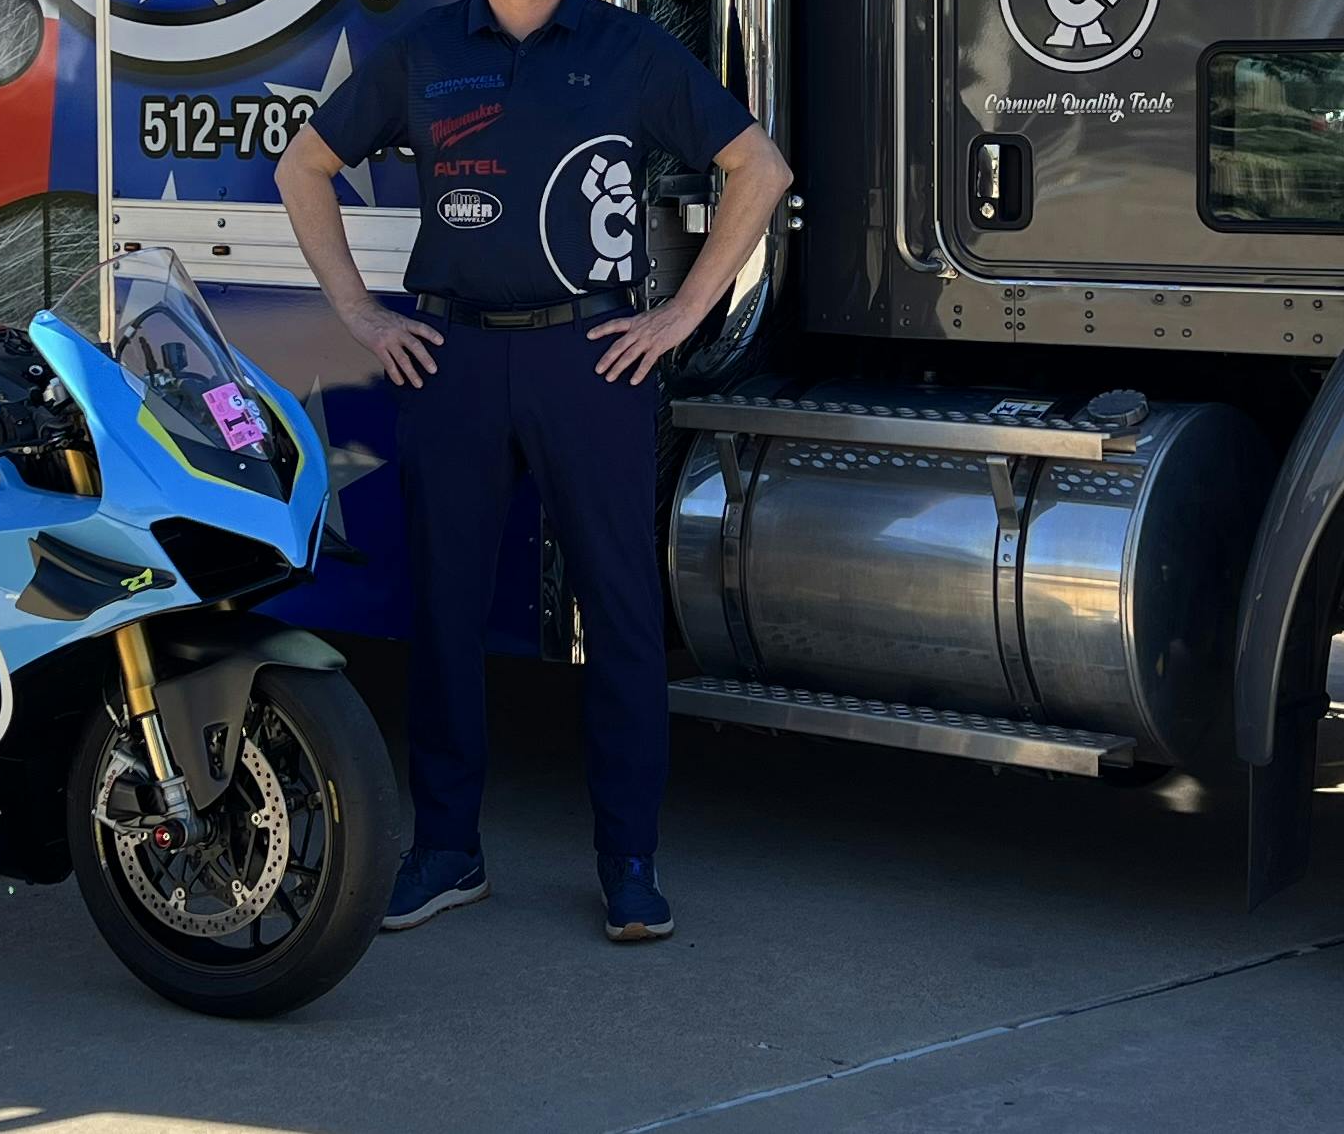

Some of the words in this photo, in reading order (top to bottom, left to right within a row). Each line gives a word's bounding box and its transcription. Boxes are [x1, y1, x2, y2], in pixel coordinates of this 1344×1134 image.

[425, 73, 504, 93] CORNWELL
[984, 93, 1057, 114] Cornwell
[1061, 91, 1125, 123] Quality
[1129, 91, 1175, 114] Tools
[433, 159, 507, 178] AUTEL
